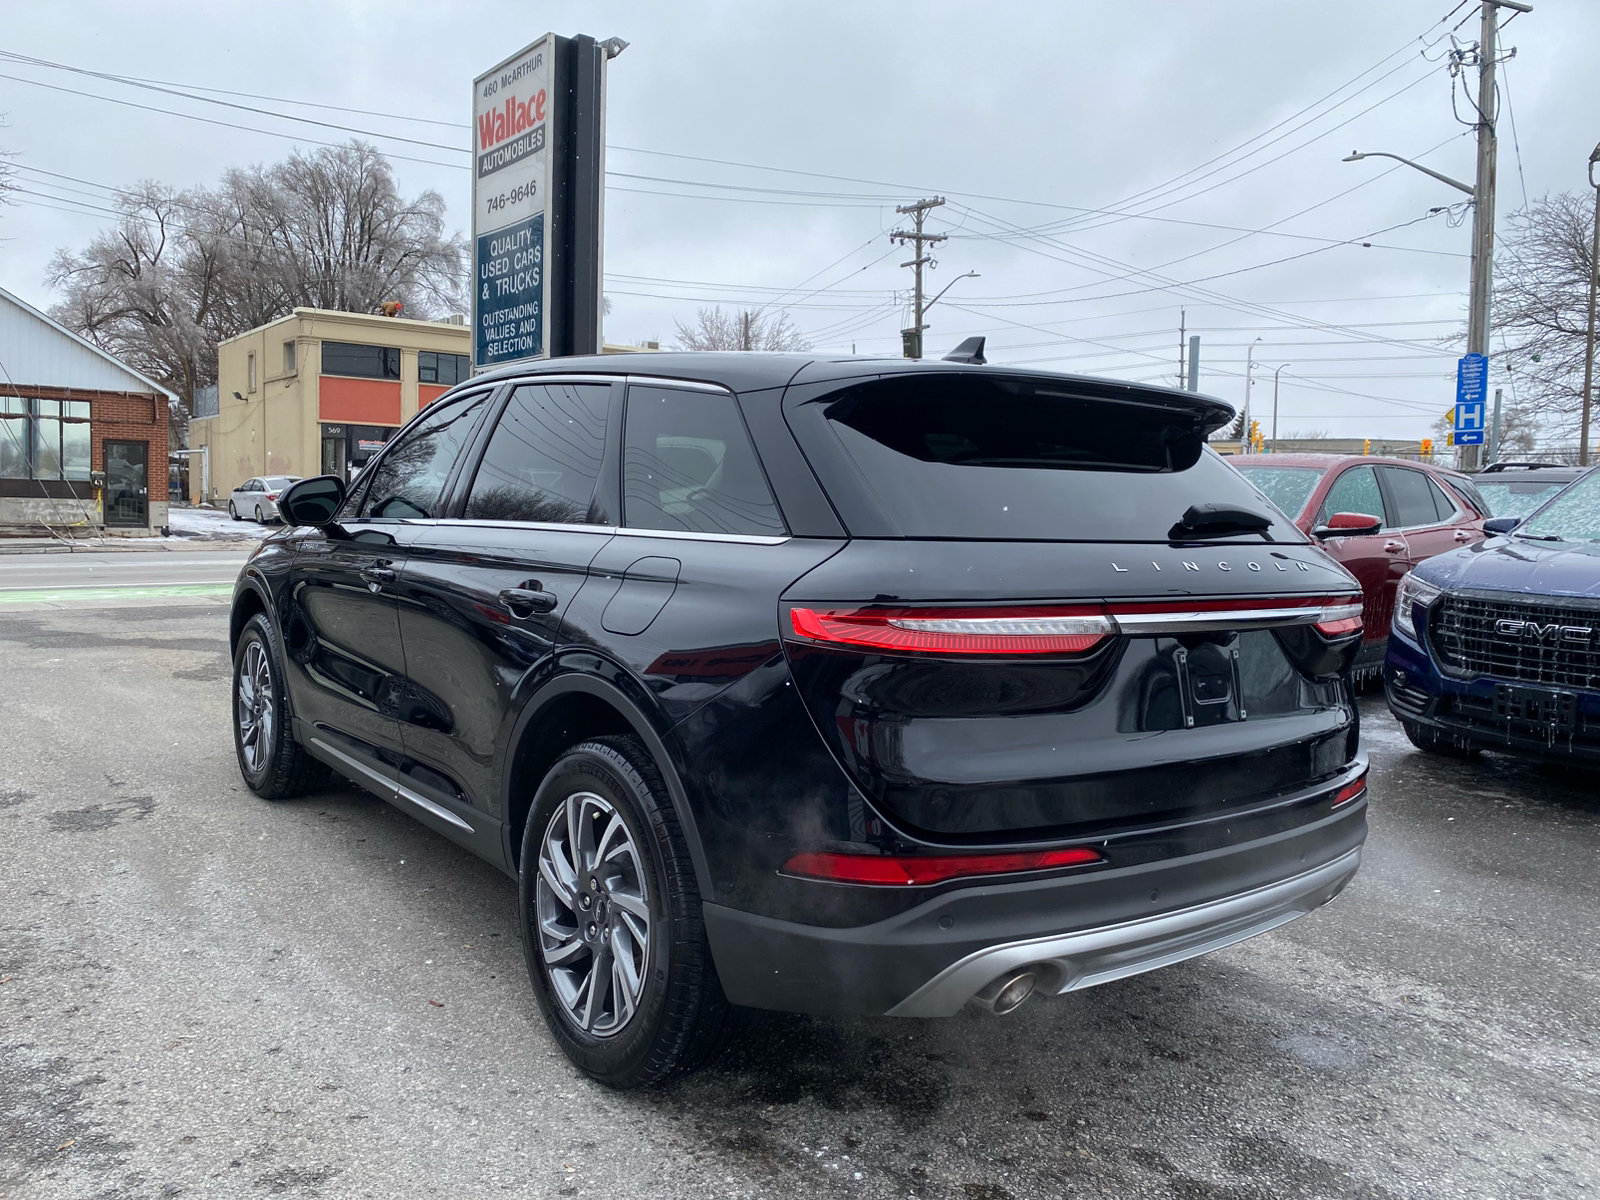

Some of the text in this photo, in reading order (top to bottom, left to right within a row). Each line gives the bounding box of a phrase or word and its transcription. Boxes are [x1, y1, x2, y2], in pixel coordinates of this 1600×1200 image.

[483, 53, 543, 99] 460 McARTHUR
[478, 88, 547, 151] Wallace
[482, 129, 543, 172] AUTOMOBILES
[487, 179, 537, 214] 746-9646
[490, 227, 533, 257] QUALITY
[481, 245, 541, 279] USED CARS
[482, 267, 540, 300] & TRUCKS
[482, 300, 539, 327] OUTSTANDING
[485, 318, 536, 341] VALUES AND
[487, 335, 533, 356] SELECTION
[328, 426, 341, 434] 569
[1459, 404, 1481, 428] H
[1111, 561, 1309, 572] LINCOLN
[1494, 618, 1593, 644] GMC
